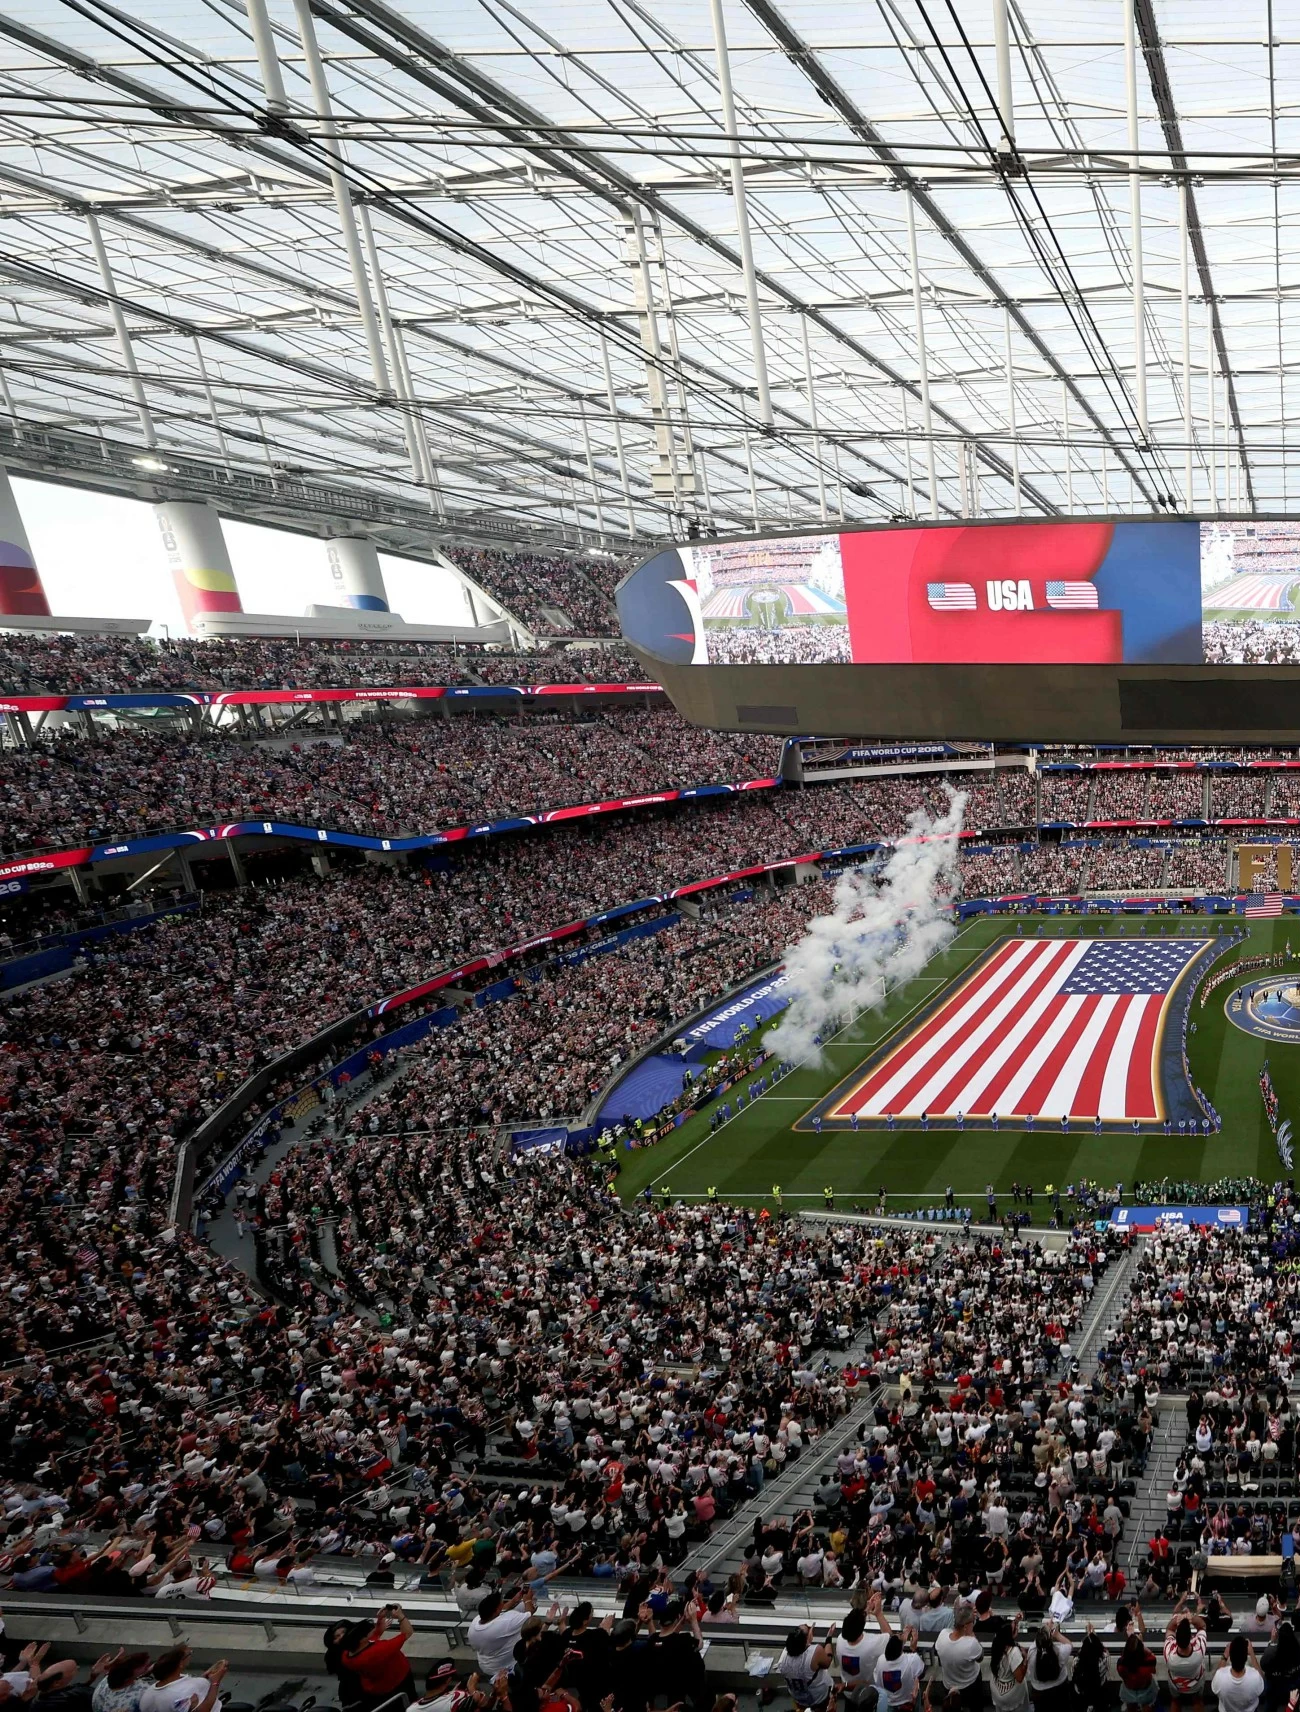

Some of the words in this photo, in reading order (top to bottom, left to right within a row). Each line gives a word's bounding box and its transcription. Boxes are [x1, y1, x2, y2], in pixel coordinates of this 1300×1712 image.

[986, 580, 1034, 611] USA
[871, 748, 900, 756] WORLD
[11, 864, 26, 872] CUP
[0, 881, 22, 895] 26
[689, 1019, 722, 1037] FIFA
[712, 997, 755, 1023] WORLD
[750, 985, 772, 1000] CUP
[1253, 1026, 1271, 1035] FIFA
[660, 1121, 675, 1137] FIFA
